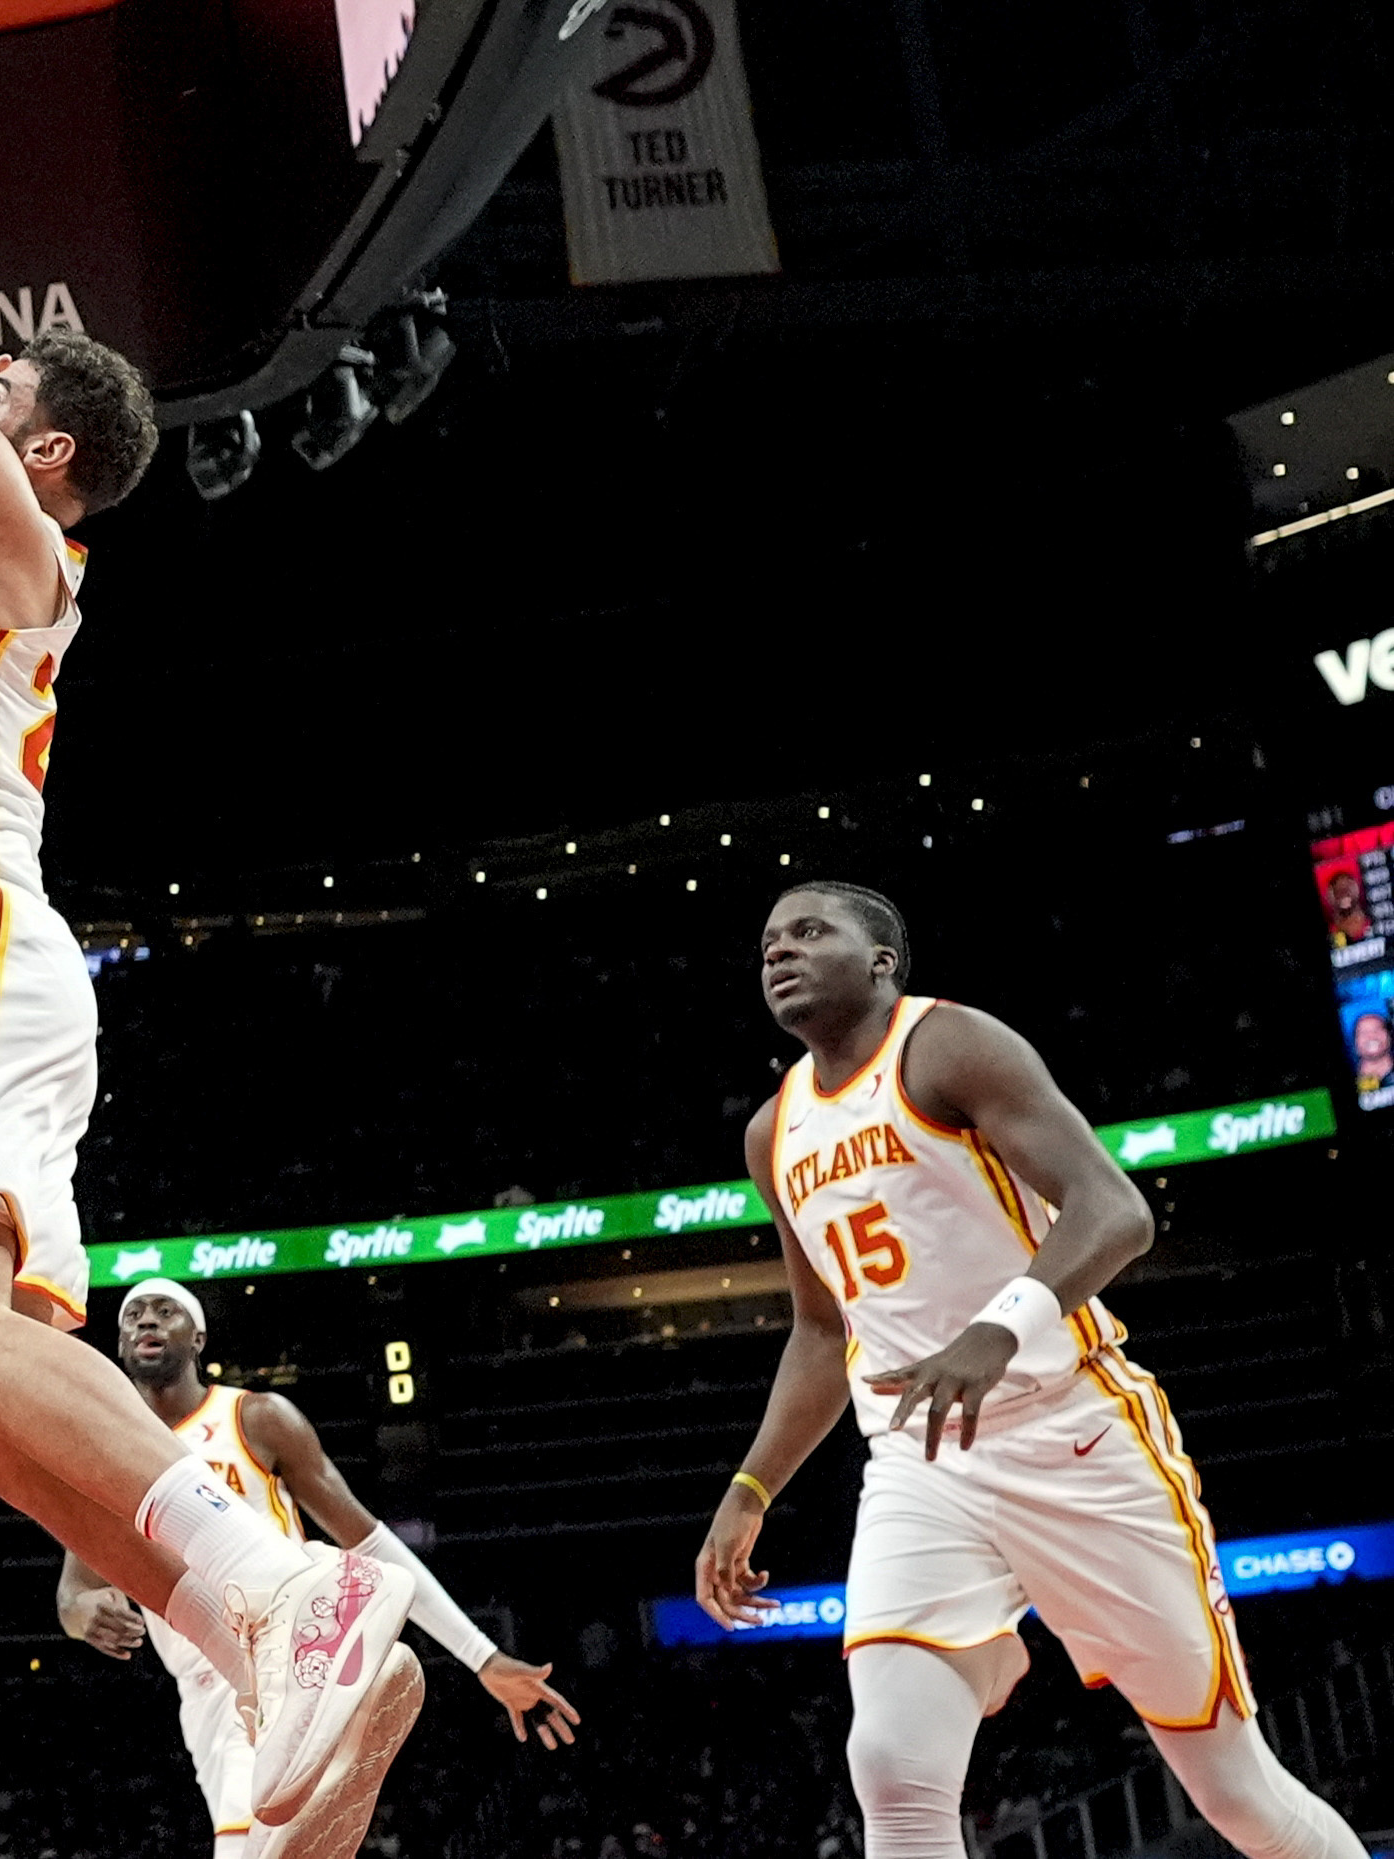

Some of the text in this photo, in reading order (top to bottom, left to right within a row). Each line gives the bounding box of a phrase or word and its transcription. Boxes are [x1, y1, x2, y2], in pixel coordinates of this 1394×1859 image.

[627, 126, 688, 167] TED
[604, 166, 728, 211] TURNER
[1207, 1102, 1306, 1154] Sprite
[786, 1122, 918, 1217] ATLANTA
[189, 1188, 746, 1277] Sprite Sprite Sprite Sprite
[823, 1200, 911, 1303] 15
[1233, 1547, 1326, 1580] CHASE
